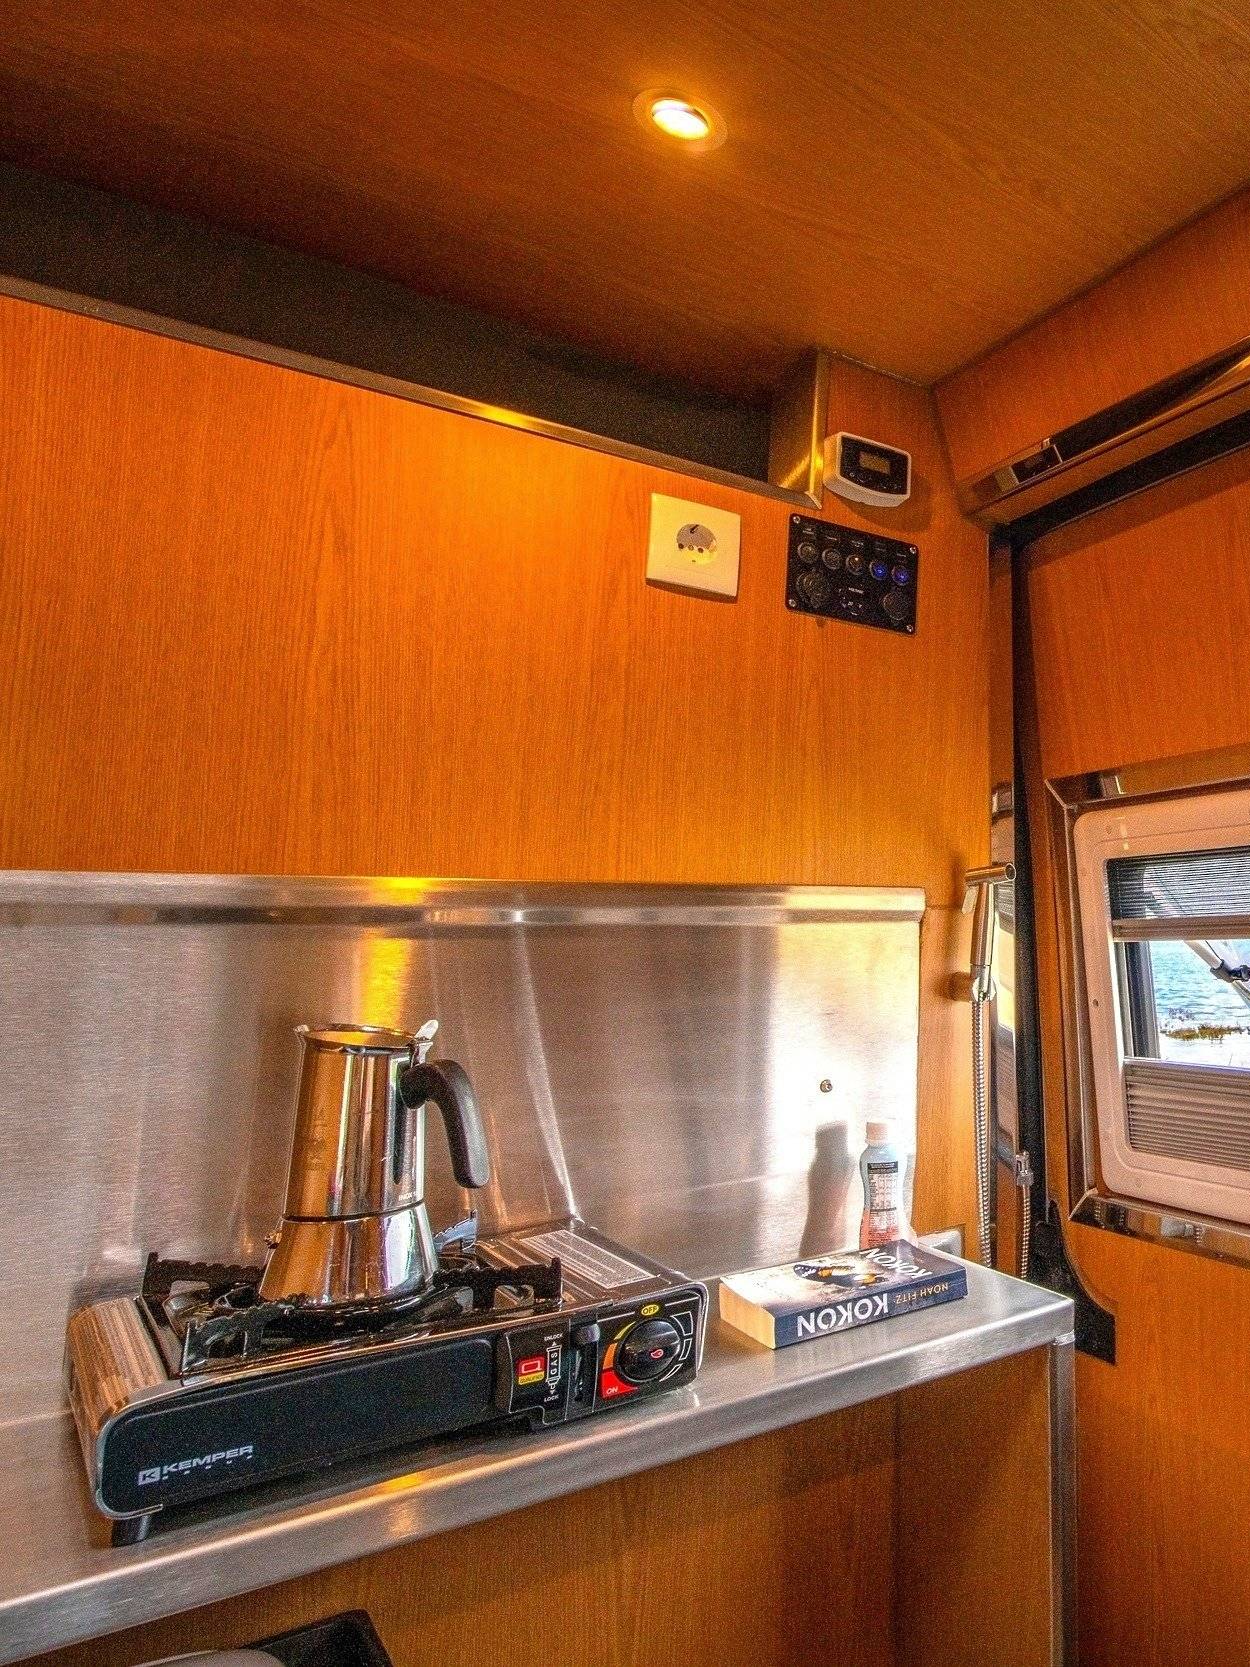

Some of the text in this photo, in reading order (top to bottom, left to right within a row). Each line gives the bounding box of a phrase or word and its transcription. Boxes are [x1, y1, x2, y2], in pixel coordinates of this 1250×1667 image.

[859, 1247, 932, 1279] KOKON
[895, 1282, 949, 1304] NOAH FITZ
[643, 1305, 659, 1315] OFF
[797, 1293, 889, 1337] KOKON
[544, 1333, 563, 1341] UNLOCK
[550, 1352, 558, 1375] GAS
[544, 1394, 559, 1402] LOCK
[606, 1387, 619, 1395] ON
[163, 1445, 254, 1474] KEMPER
